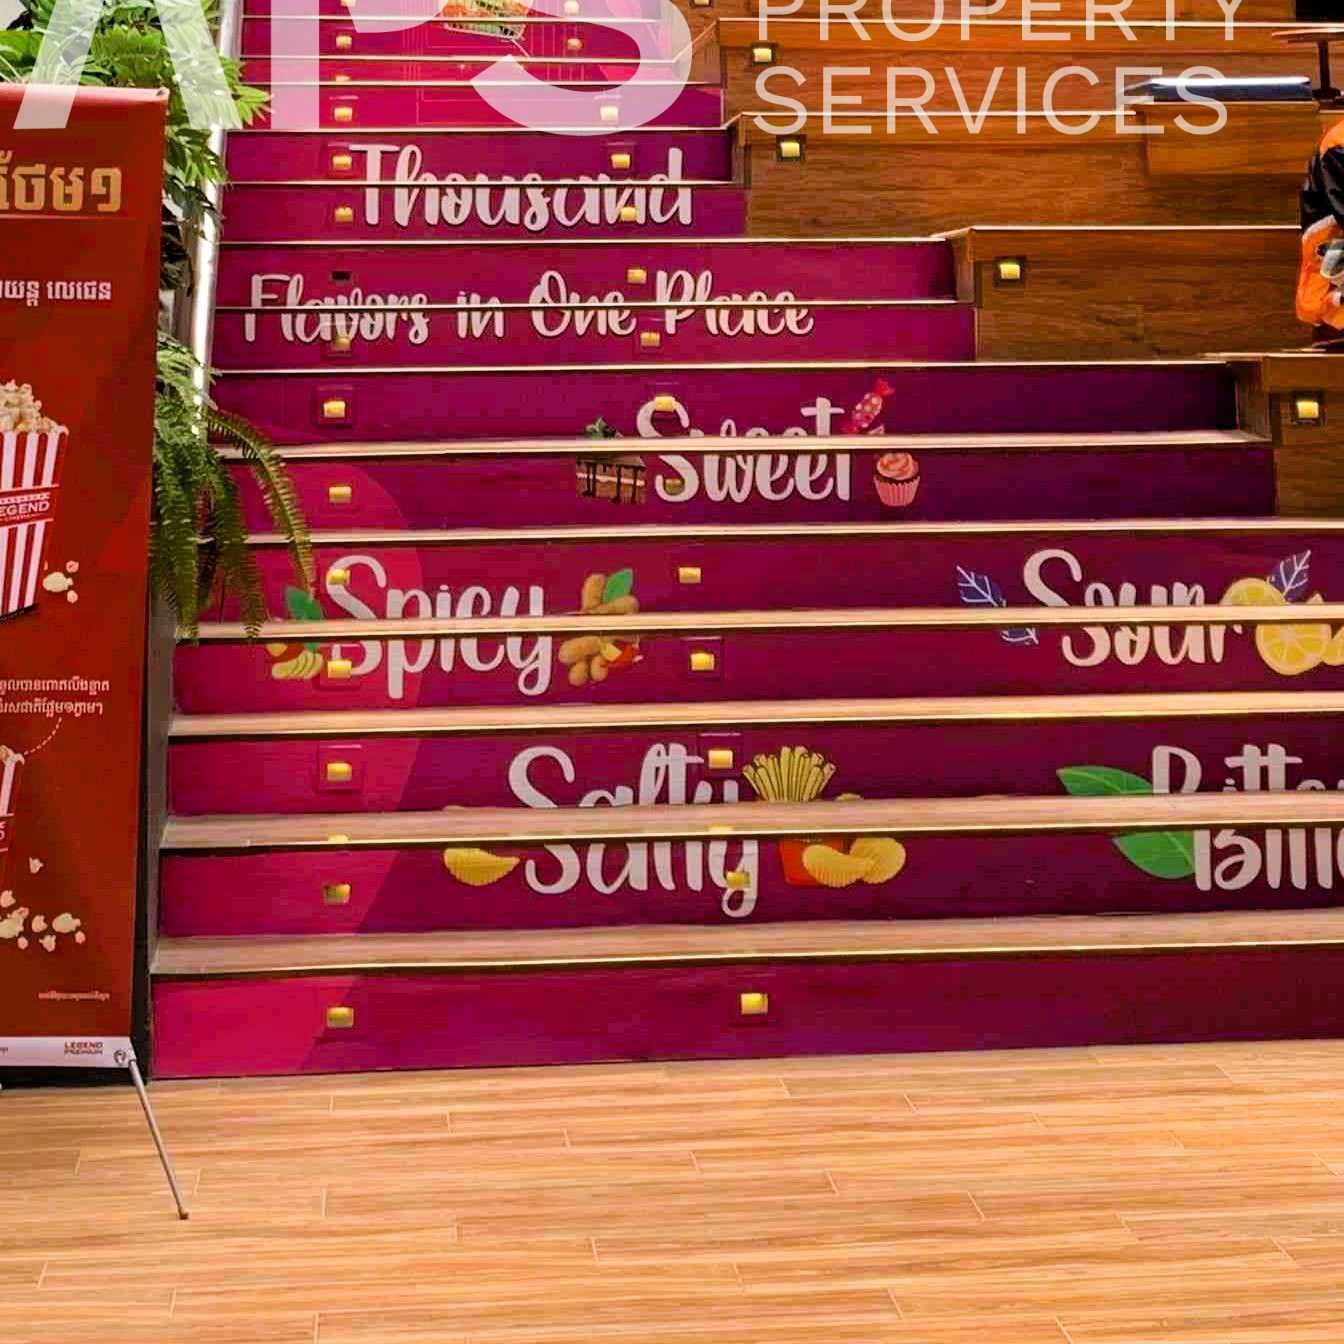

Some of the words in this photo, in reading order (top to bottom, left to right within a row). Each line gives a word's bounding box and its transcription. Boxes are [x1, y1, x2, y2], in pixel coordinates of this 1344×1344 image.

[349, 143, 693, 231] Thousand
[244, 273, 432, 345] Flavors
[457, 290, 505, 339] in
[529, 269, 638, 339] One
[656, 268, 815, 337] Place
[636, 396, 851, 503] Sweet
[326, 555, 553, 699] Spicy
[1023, 549, 1243, 667] Sour
[508, 742, 759, 917] Salty
